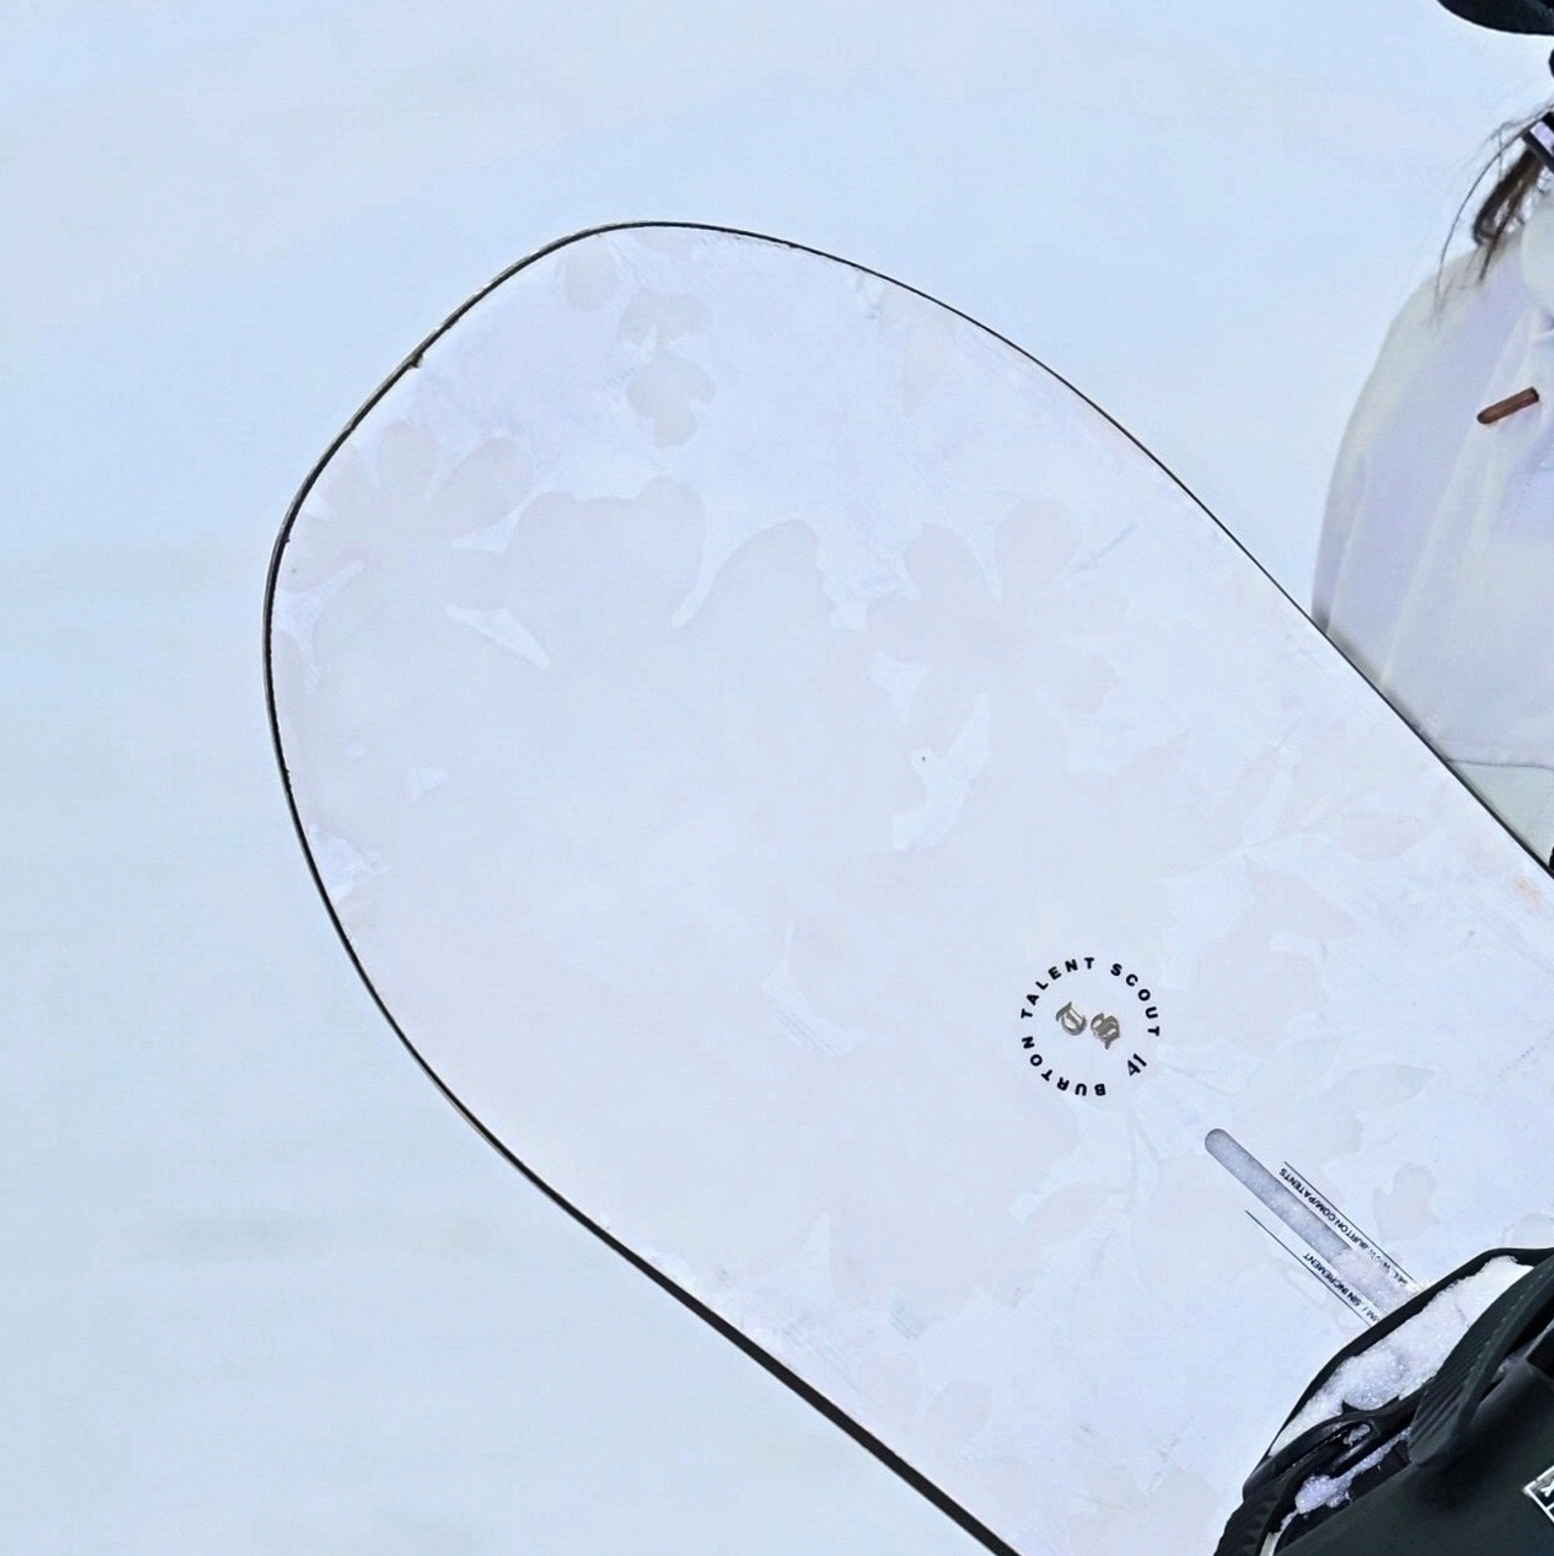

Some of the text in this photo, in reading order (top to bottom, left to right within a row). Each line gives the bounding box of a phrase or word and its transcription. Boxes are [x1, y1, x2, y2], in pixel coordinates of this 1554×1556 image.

[1020, 956, 1161, 1097] BURTON TALENT SCOUT
[1127, 1053, 1148, 1077] 41
[1302, 1252, 1349, 1295] INCREMENT
